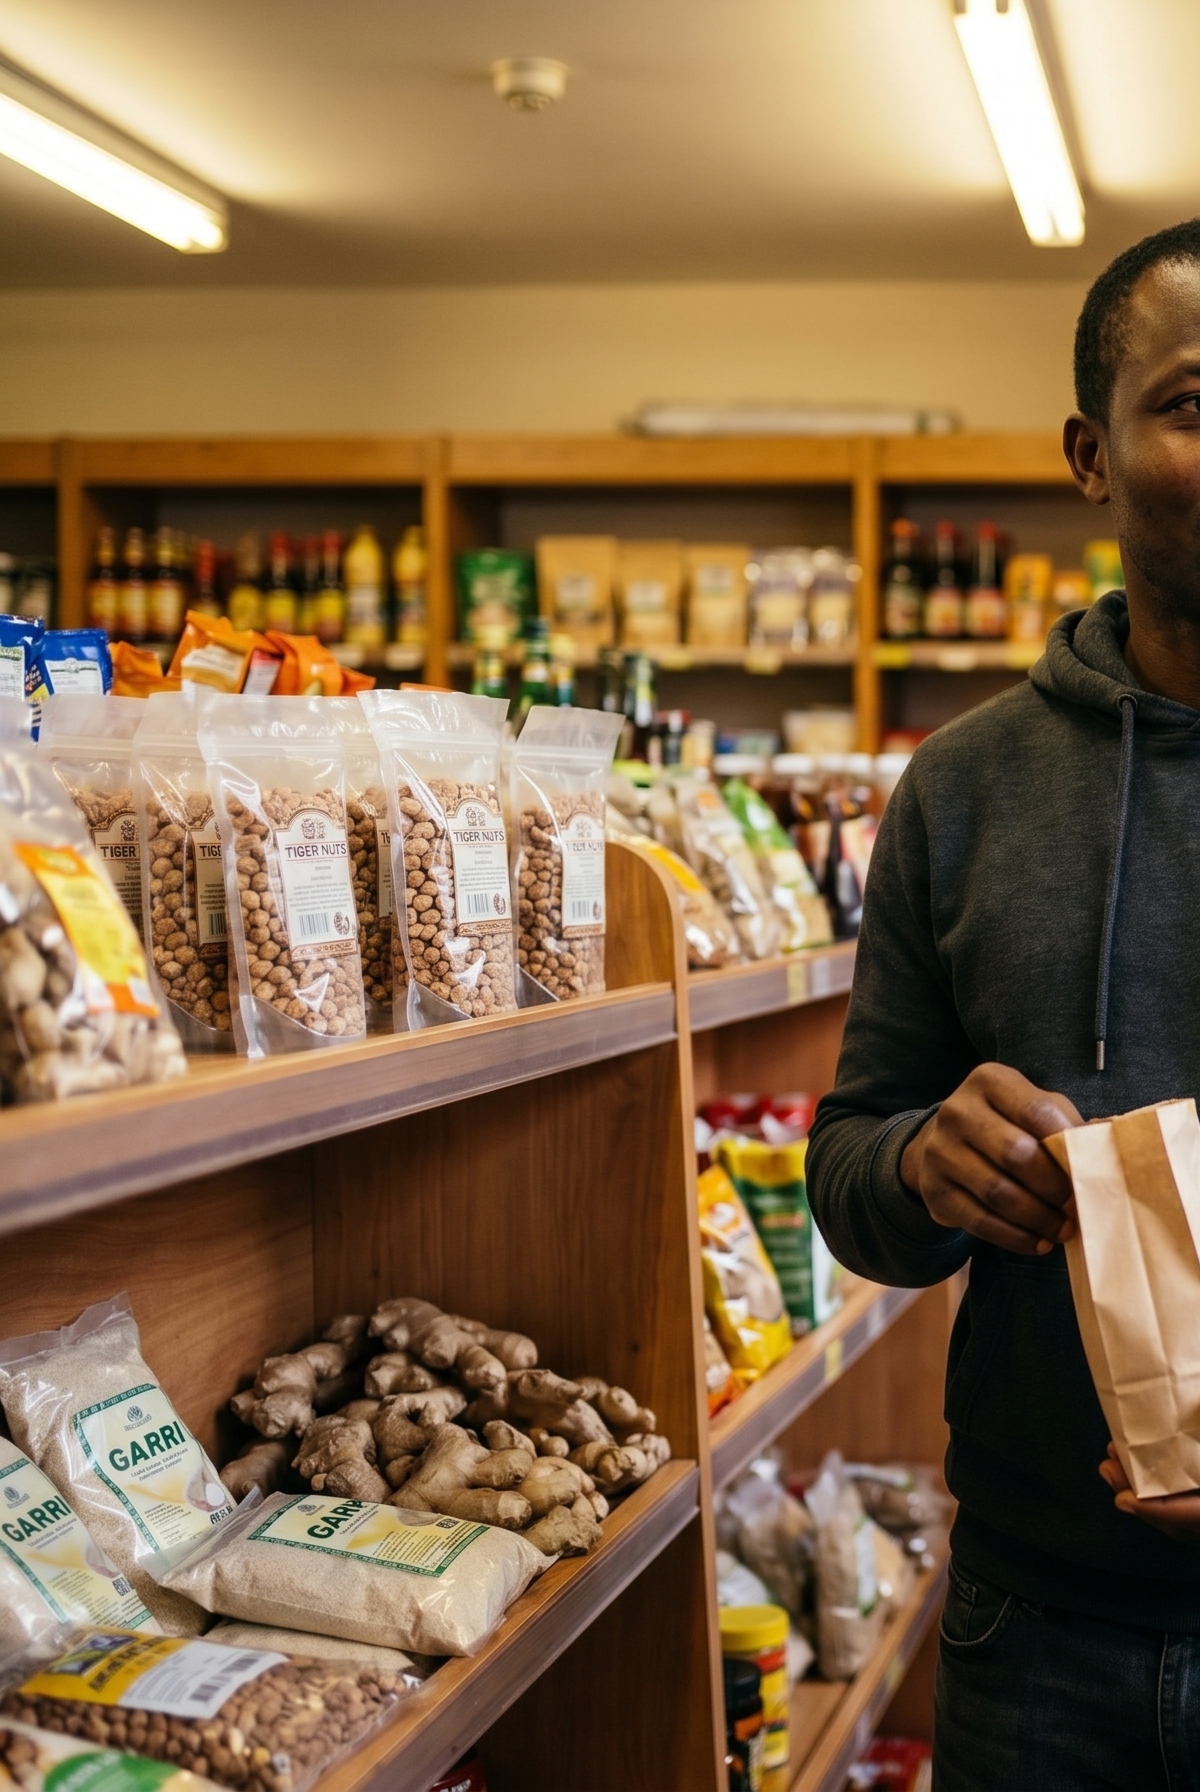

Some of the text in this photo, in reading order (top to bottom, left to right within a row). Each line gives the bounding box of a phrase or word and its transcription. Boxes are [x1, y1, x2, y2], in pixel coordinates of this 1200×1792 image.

[454, 831, 481, 843] TIGER
[100, 845, 136, 858] TIGER
[285, 843, 347, 858] TIGER NUTS
[108, 1421, 186, 1472] GARRI
[1, 1495, 72, 1542] GARRI
